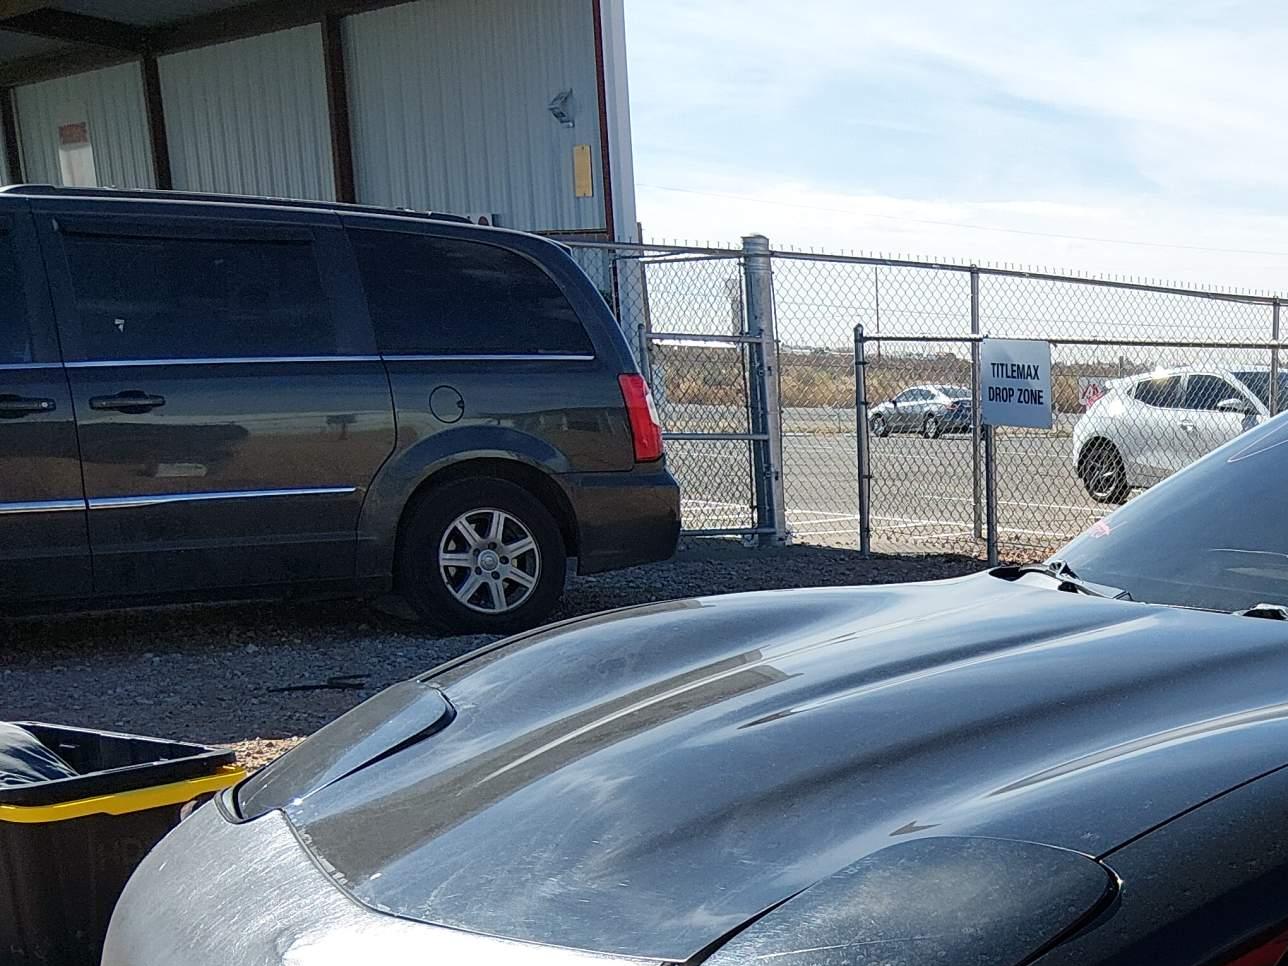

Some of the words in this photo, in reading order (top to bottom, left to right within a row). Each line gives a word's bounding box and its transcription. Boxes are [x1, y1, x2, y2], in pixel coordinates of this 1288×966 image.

[990, 362, 1040, 380] TITLEMAX
[988, 386, 1015, 403] DROP
[1017, 388, 1044, 405] ZONE
